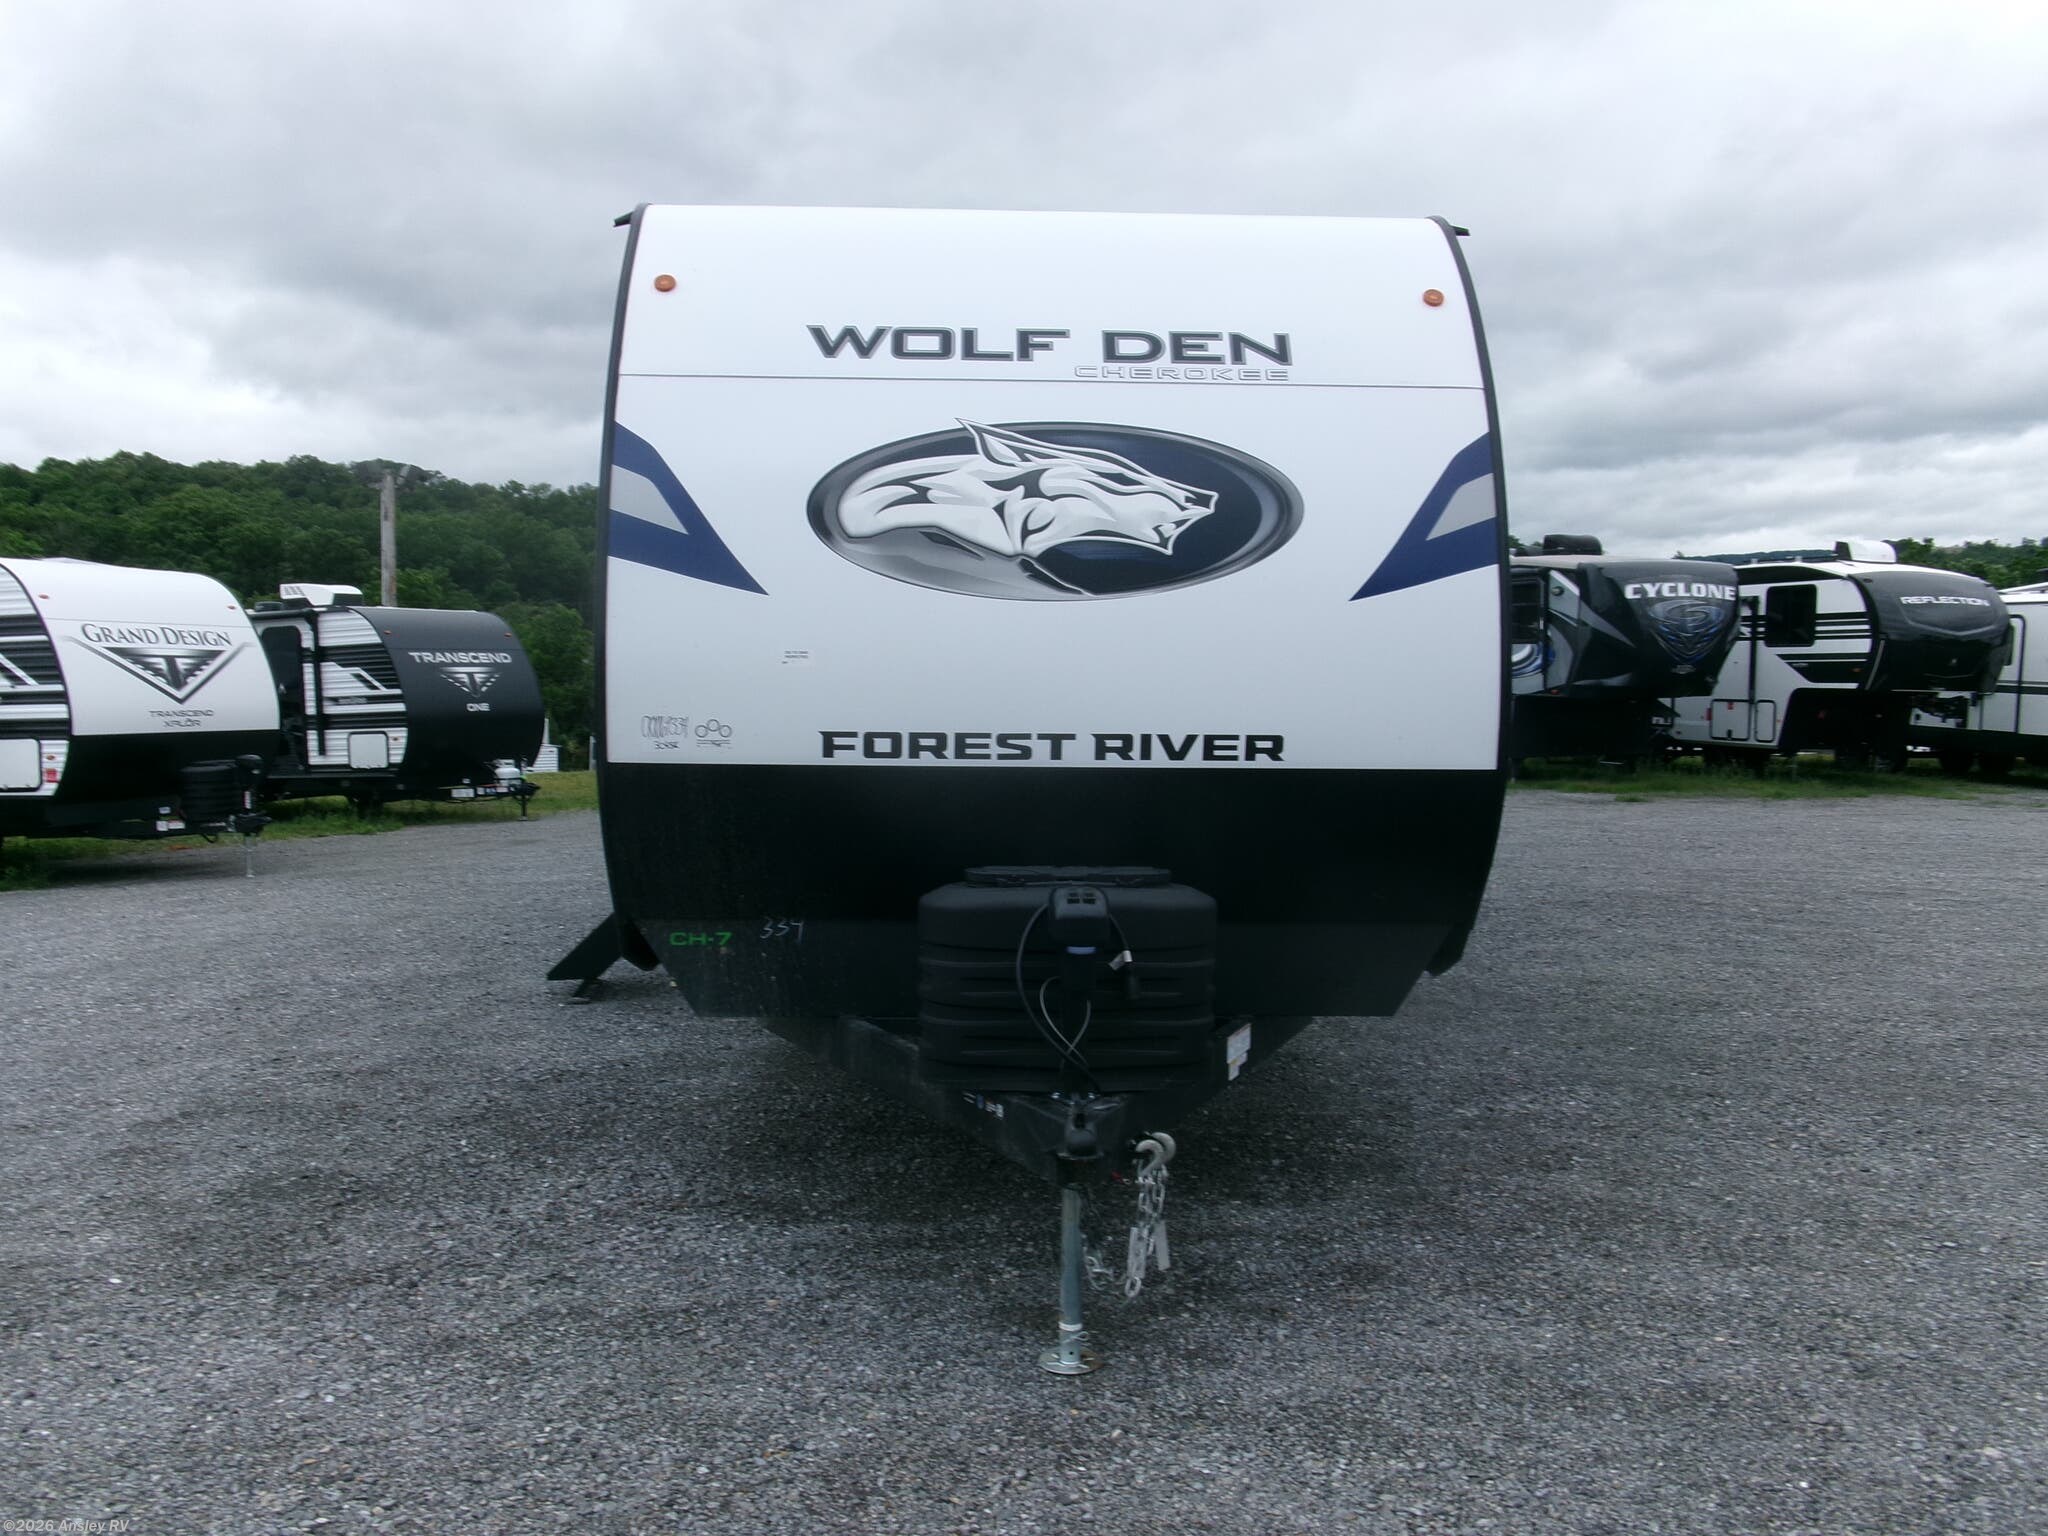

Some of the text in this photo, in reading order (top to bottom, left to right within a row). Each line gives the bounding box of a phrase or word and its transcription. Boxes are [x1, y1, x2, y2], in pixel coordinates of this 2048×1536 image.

[806, 325, 1293, 366] WOLF DEN
[1074, 366, 1288, 381] CHEROKEE
[1624, 582, 1736, 600] CYCLONE
[1900, 596, 1990, 606] REFLECTION
[81, 623, 232, 646] GRAND DESIGN
[408, 651, 512, 663] TRANSCEND
[149, 709, 214, 717] TRANSCEND
[466, 703, 490, 711] ONE
[818, 731, 1285, 762] FOREST RIVER
[669, 932, 732, 946] CH-7
